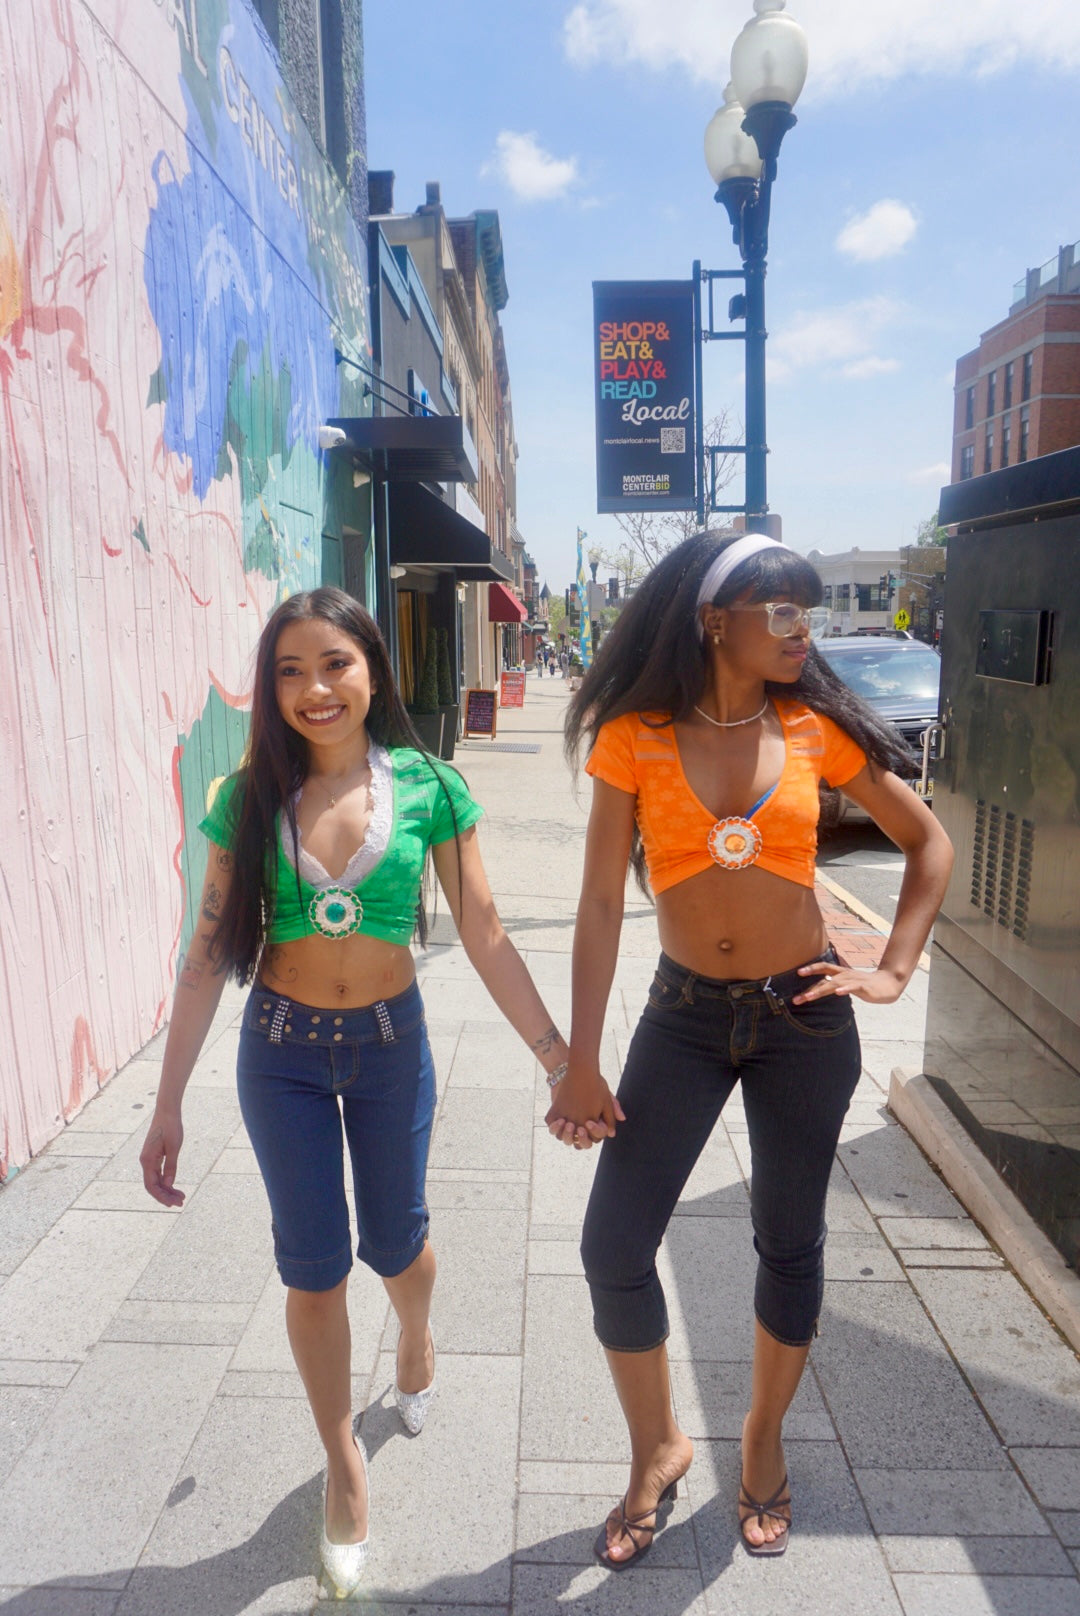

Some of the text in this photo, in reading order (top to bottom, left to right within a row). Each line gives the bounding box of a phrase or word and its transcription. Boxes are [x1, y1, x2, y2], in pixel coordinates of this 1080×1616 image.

[219, 44, 301, 222] CENTER
[600, 380, 657, 400] READ
[621, 397, 690, 426] Local
[622, 474, 670, 483] MONTCLAIR
